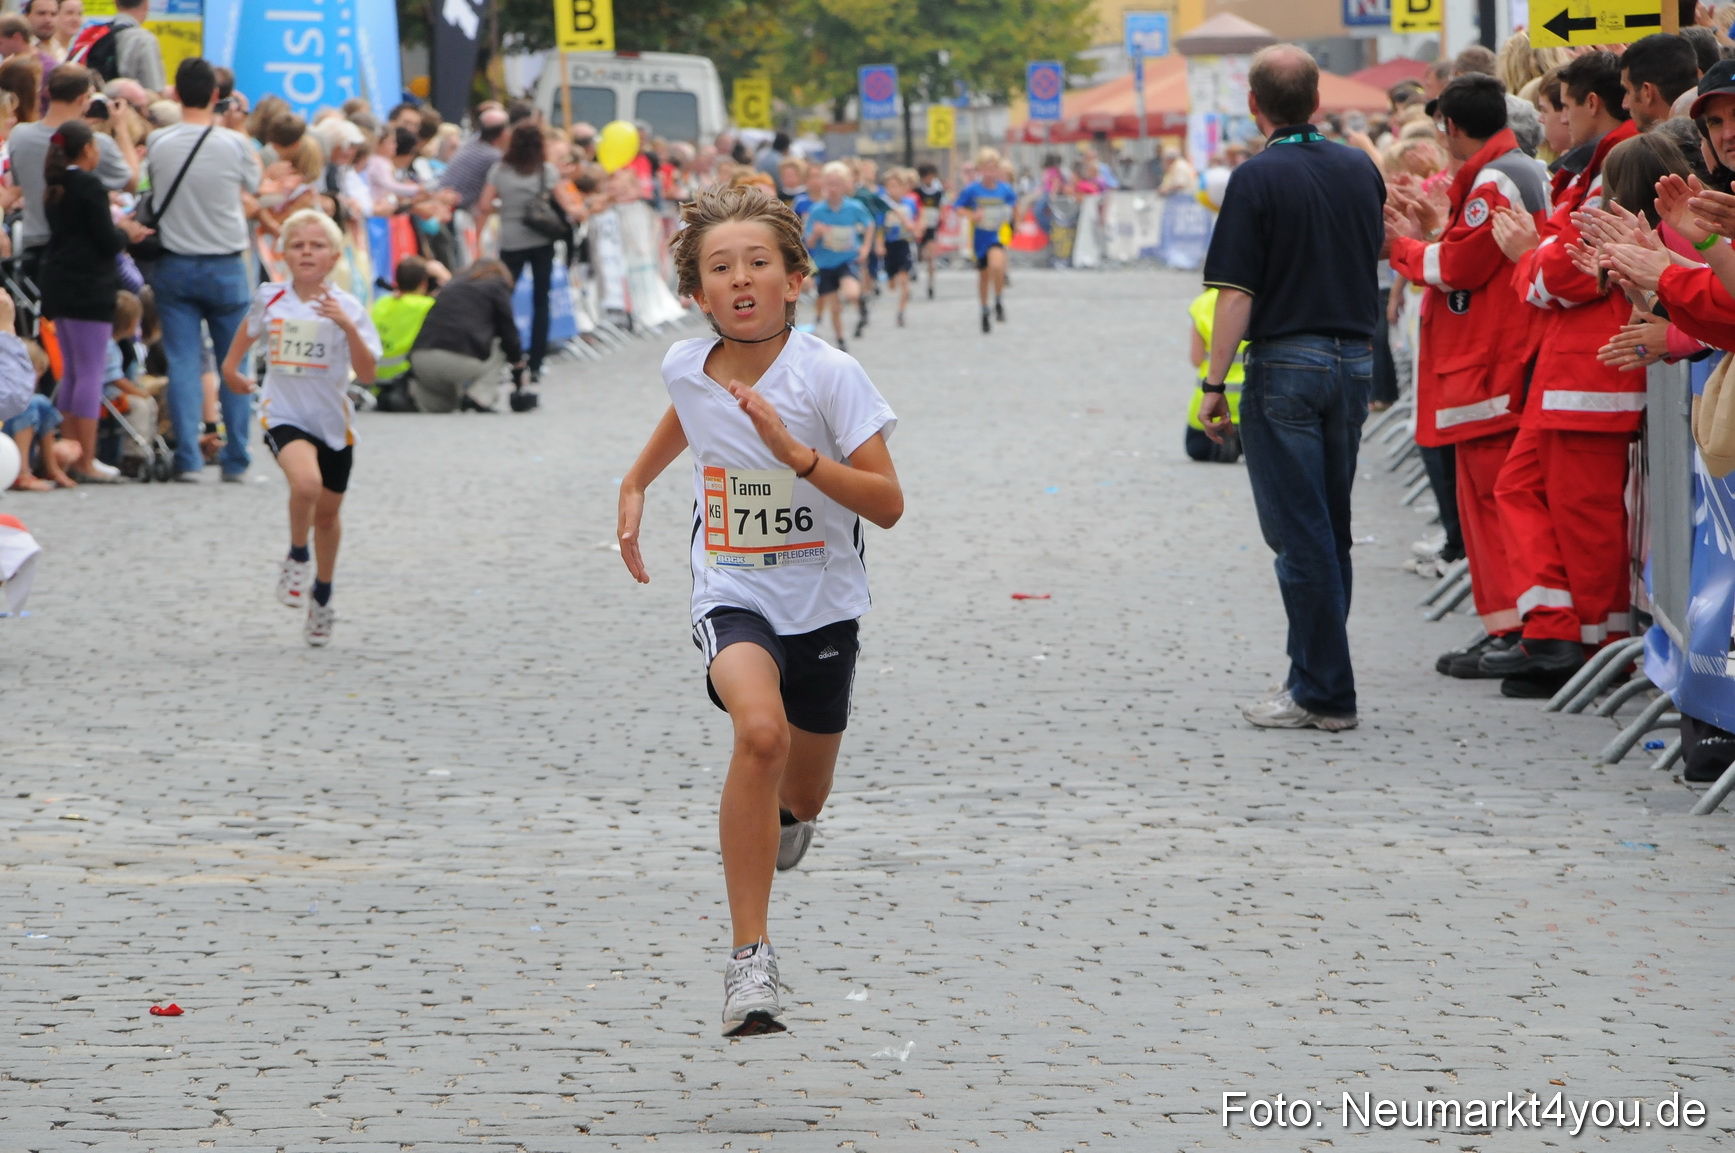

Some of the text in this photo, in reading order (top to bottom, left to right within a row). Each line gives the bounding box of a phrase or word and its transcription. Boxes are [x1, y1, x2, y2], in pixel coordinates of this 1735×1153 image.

[573, 0, 597, 31] B
[743, 95, 761, 120] C
[283, 340, 326, 359] 7123
[730, 476, 771, 496] Tamo
[709, 503, 721, 519] K6
[734, 506, 813, 535] 7156
[778, 547, 825, 560] PFLEIDERER
